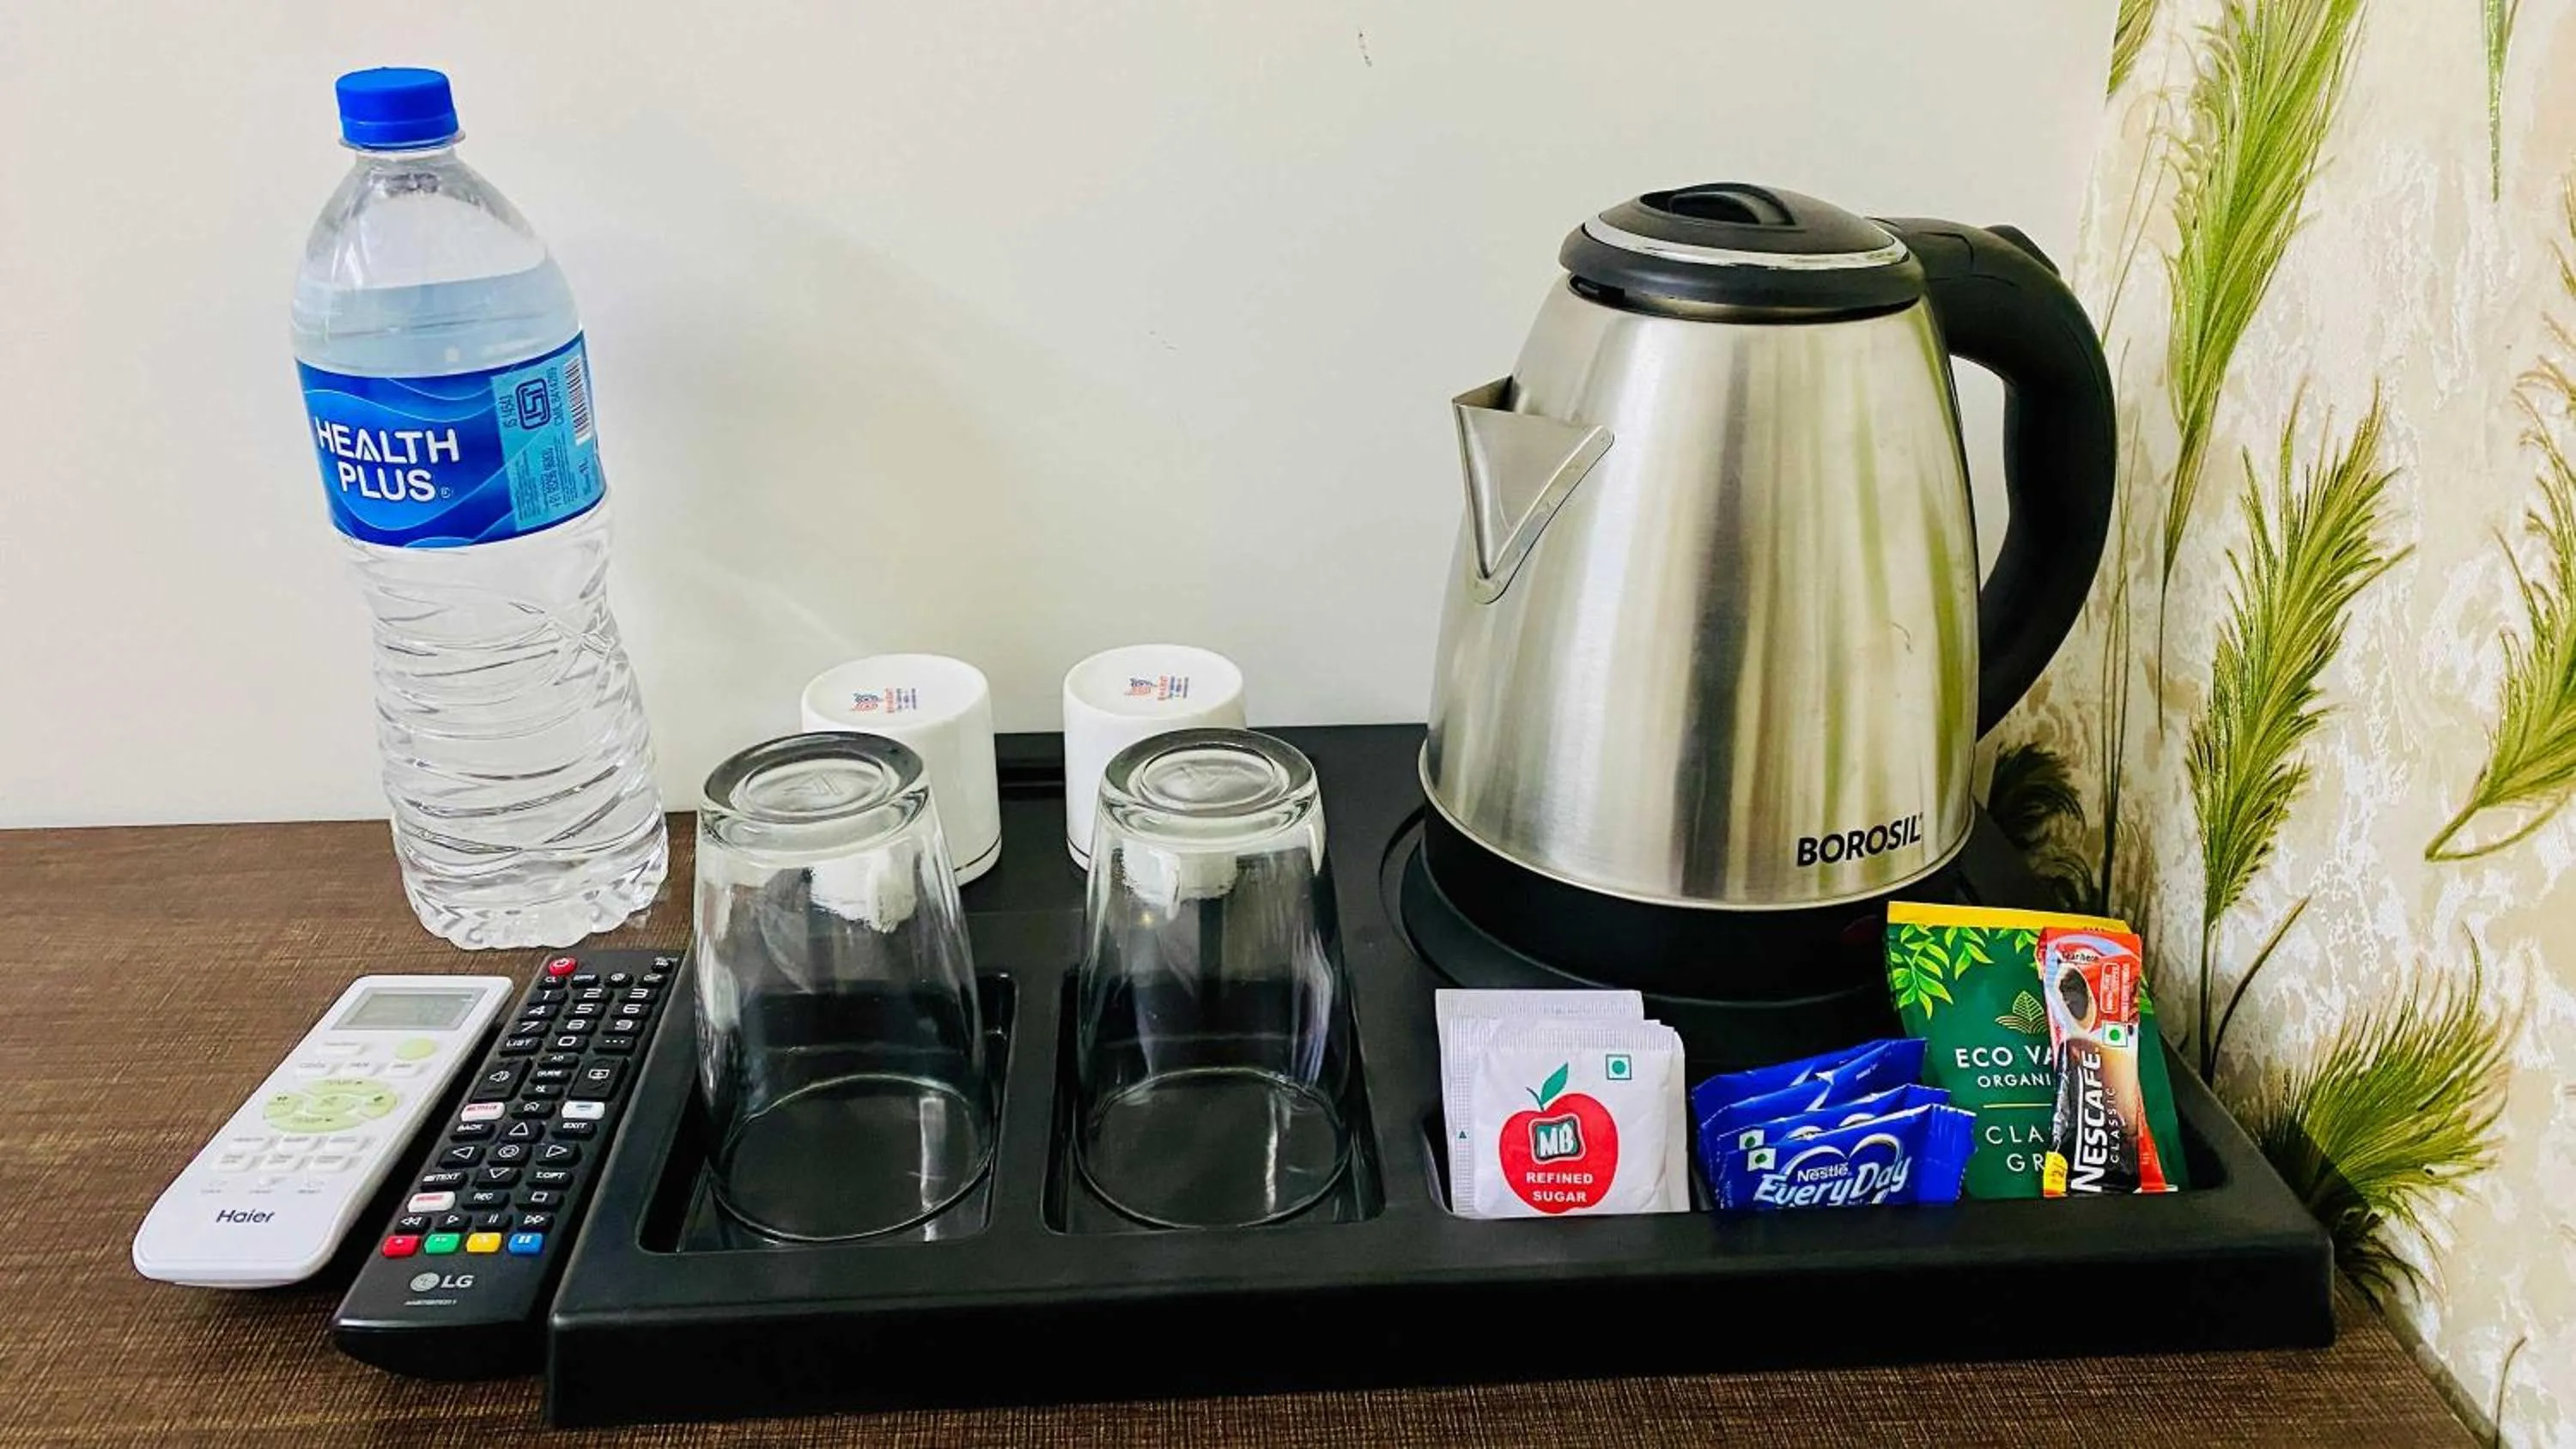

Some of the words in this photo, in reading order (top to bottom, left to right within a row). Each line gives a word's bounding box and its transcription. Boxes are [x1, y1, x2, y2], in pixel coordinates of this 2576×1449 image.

[314, 416, 460, 464] HEALTH
[337, 461, 435, 502] PLUS
[1796, 816, 1921, 867] BOROSIL
[544, 990, 552, 1000] 1
[583, 988, 602, 998] 2
[629, 988, 649, 998] 3
[528, 1005, 545, 1016] 4
[574, 1003, 595, 1014] 5
[623, 1003, 641, 1014] 6
[521, 1021, 540, 1033] 7
[567, 1019, 586, 1029] 8
[615, 1019, 633, 1030] 9
[558, 1035, 577, 1046] 0
[1954, 1046, 2014, 1069] ECO
[1977, 1073, 2051, 1088] ORGANI
[456, 1123, 483, 1131] BACK
[2105, 1084, 2120, 1164] CLASSIC
[1540, 1124, 1574, 1157] MB
[1984, 1125, 2044, 1144] CLA
[2006, 1153, 2045, 1172] GR
[1526, 1172, 1594, 1185] REFINED
[1797, 1162, 1850, 1182] Nestlé
[1753, 1156, 1912, 1206] EveryDay
[1532, 1190, 1588, 1203] SUGAR
[216, 1209, 275, 1223] Haier
[440, 1275, 475, 1288] LG
